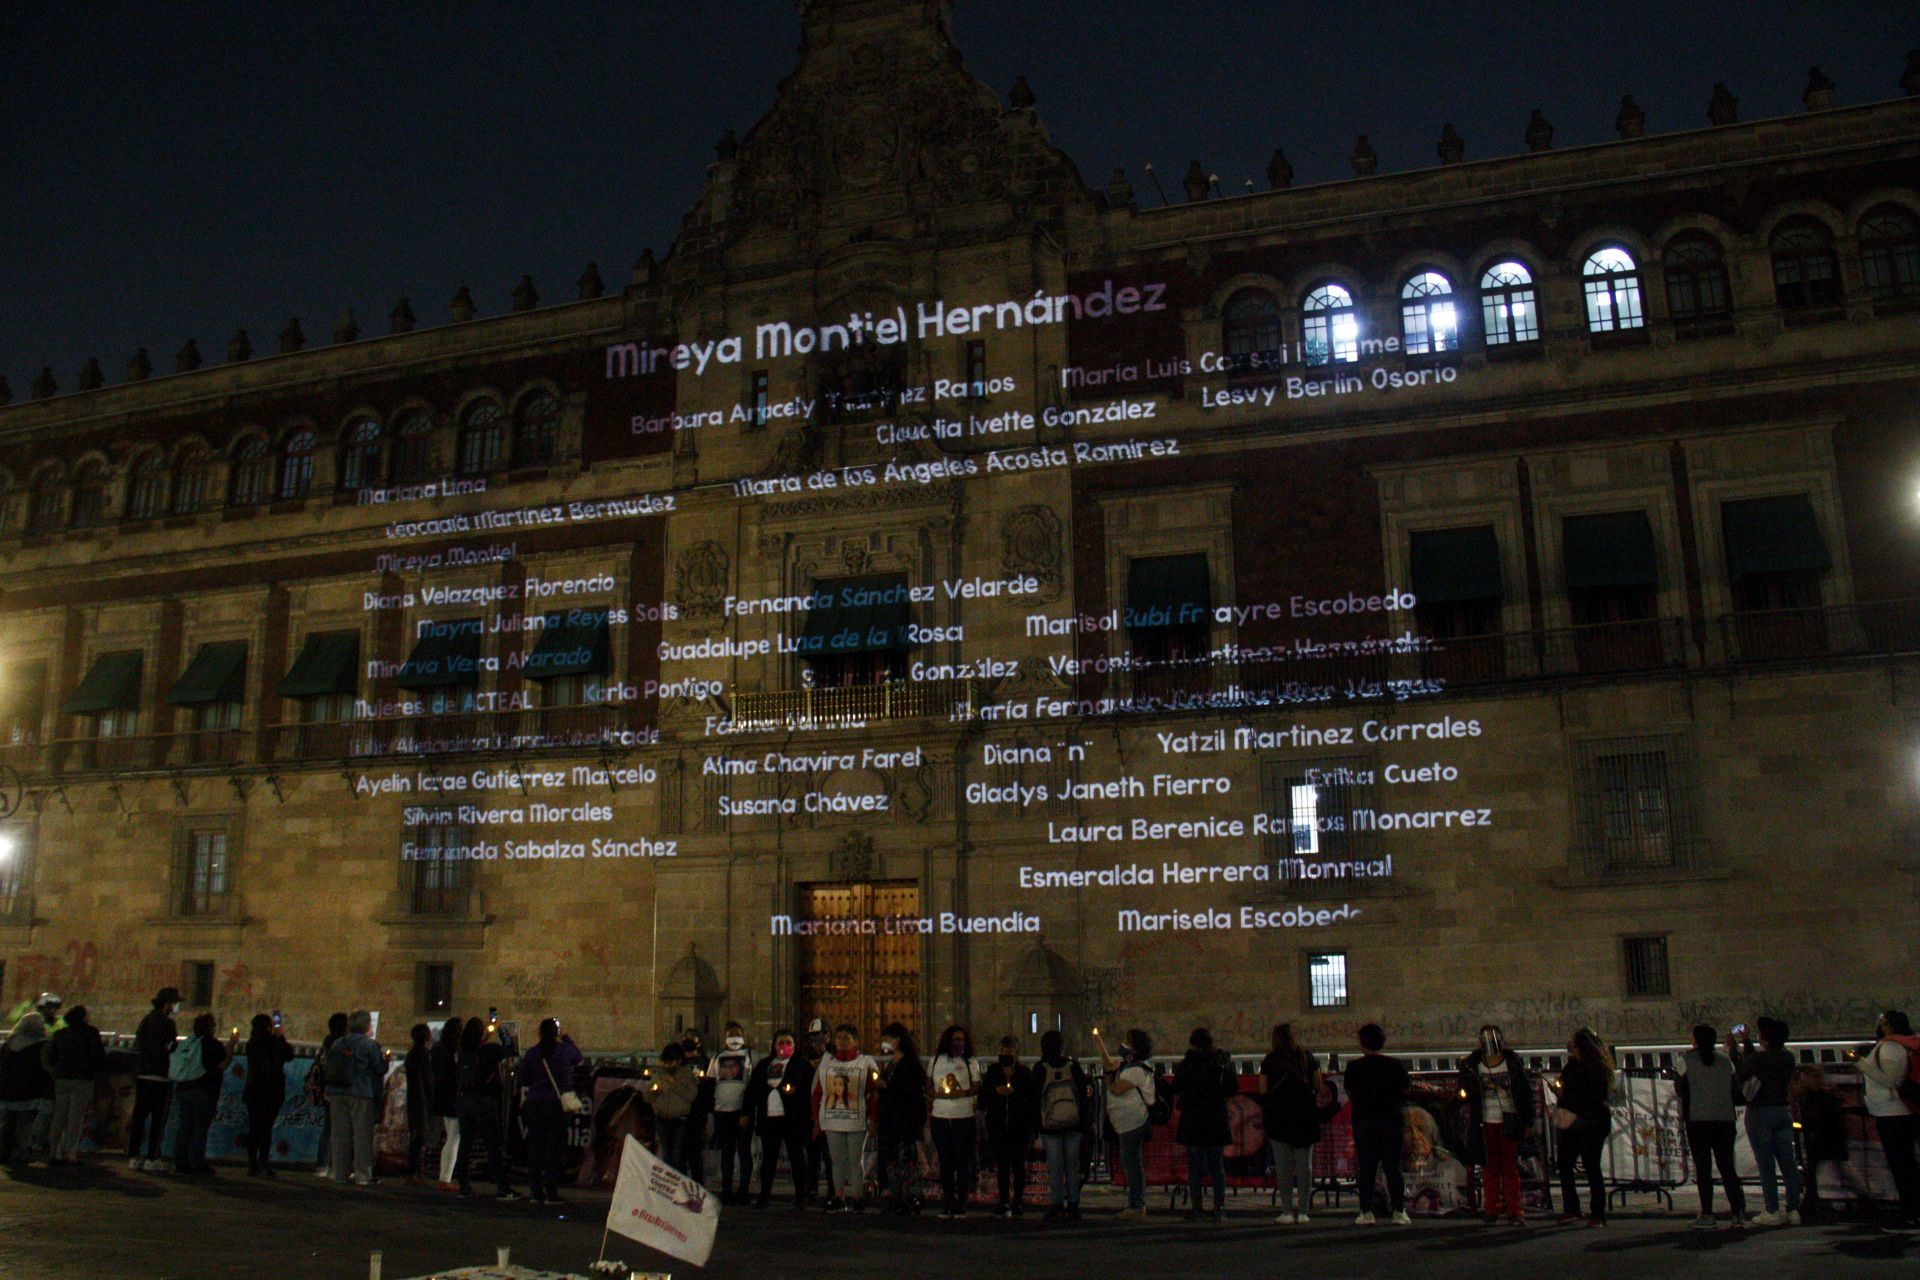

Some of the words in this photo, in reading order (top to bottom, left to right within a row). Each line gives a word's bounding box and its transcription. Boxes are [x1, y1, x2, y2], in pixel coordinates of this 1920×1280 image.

[605, 335, 742, 379] Mireya
[756, 305, 908, 360] Montiel
[917, 279, 1168, 339] Hernández
[1062, 362, 1138, 388] María
[1202, 384, 1277, 408] Lesvy
[1287, 374, 1362, 399] Berlin
[1371, 366, 1457, 390] Osorio
[730, 397, 815, 424] Aracely
[934, 375, 1016, 400] Ramos
[876, 417, 962, 445] Claudia
[969, 410, 1035, 436] Ivette
[1042, 399, 1157, 428] González
[807, 469, 838, 490] de
[842, 466, 877, 487] los
[986, 446, 1069, 473] Acosta
[357, 483, 437, 506] Mariana
[441, 478, 487, 497] Lima
[375, 553, 442, 573] Mireya
[447, 541, 517, 566] Montiel
[363, 590, 415, 610] Diana
[420, 583, 519, 606] Velazquez
[525, 573, 616, 598] Florencio
[724, 589, 833, 617] Fernanda
[840, 582, 935, 608] Sánchez
[943, 572, 1039, 600] Velarde
[416, 619, 484, 640] Mayra
[489, 612, 560, 635] Juliana
[565, 605, 629, 629] Reyes
[1026, 608, 1118, 637] Marisol
[1290, 587, 1417, 618] Escobedo
[658, 633, 770, 661] Guadalupe
[777, 632, 824, 653] Luna
[830, 626, 859, 648] de
[867, 626, 889, 647] la
[901, 622, 964, 645] Rosa
[366, 657, 440, 680] Minerva
[446, 655, 500, 674] Vera
[505, 646, 593, 670] Alvarado
[353, 697, 425, 718] Mujeres
[431, 692, 457, 713] de
[463, 689, 534, 712] ACTEAL
[583, 680, 638, 704] Karla
[644, 676, 723, 700] Pontigo
[1156, 728, 1226, 754] Yatzil
[1362, 715, 1482, 743] Corrales
[703, 754, 757, 777] Alma
[763, 751, 856, 774] Chavira
[983, 742, 1051, 766] Diana
[356, 772, 411, 797] Ayelin
[471, 766, 566, 790] Gutierrez
[572, 763, 657, 786] Marcelo
[1384, 761, 1459, 784] Cueto
[718, 794, 797, 817] Susana
[804, 791, 889, 813] Chávez
[965, 780, 1048, 807] Gladys
[1057, 773, 1145, 800] Janeth
[1153, 774, 1231, 796] Fierro
[457, 804, 524, 825] Rivera
[529, 801, 614, 823] Morales
[1048, 821, 1124, 843] Laura
[1131, 815, 1245, 840] Berenice
[1352, 806, 1492, 831] Monarrez
[401, 840, 500, 862] Fernanda
[503, 838, 585, 860] Sabalza
[591, 836, 678, 858] Sánchez
[1020, 859, 1155, 888] Esmeralda
[1162, 859, 1269, 885] Herrera
[1278, 853, 1393, 881] Monreal
[771, 912, 876, 936] Mariana
[939, 910, 1040, 934] Buendía
[1118, 905, 1232, 932] Marisela
